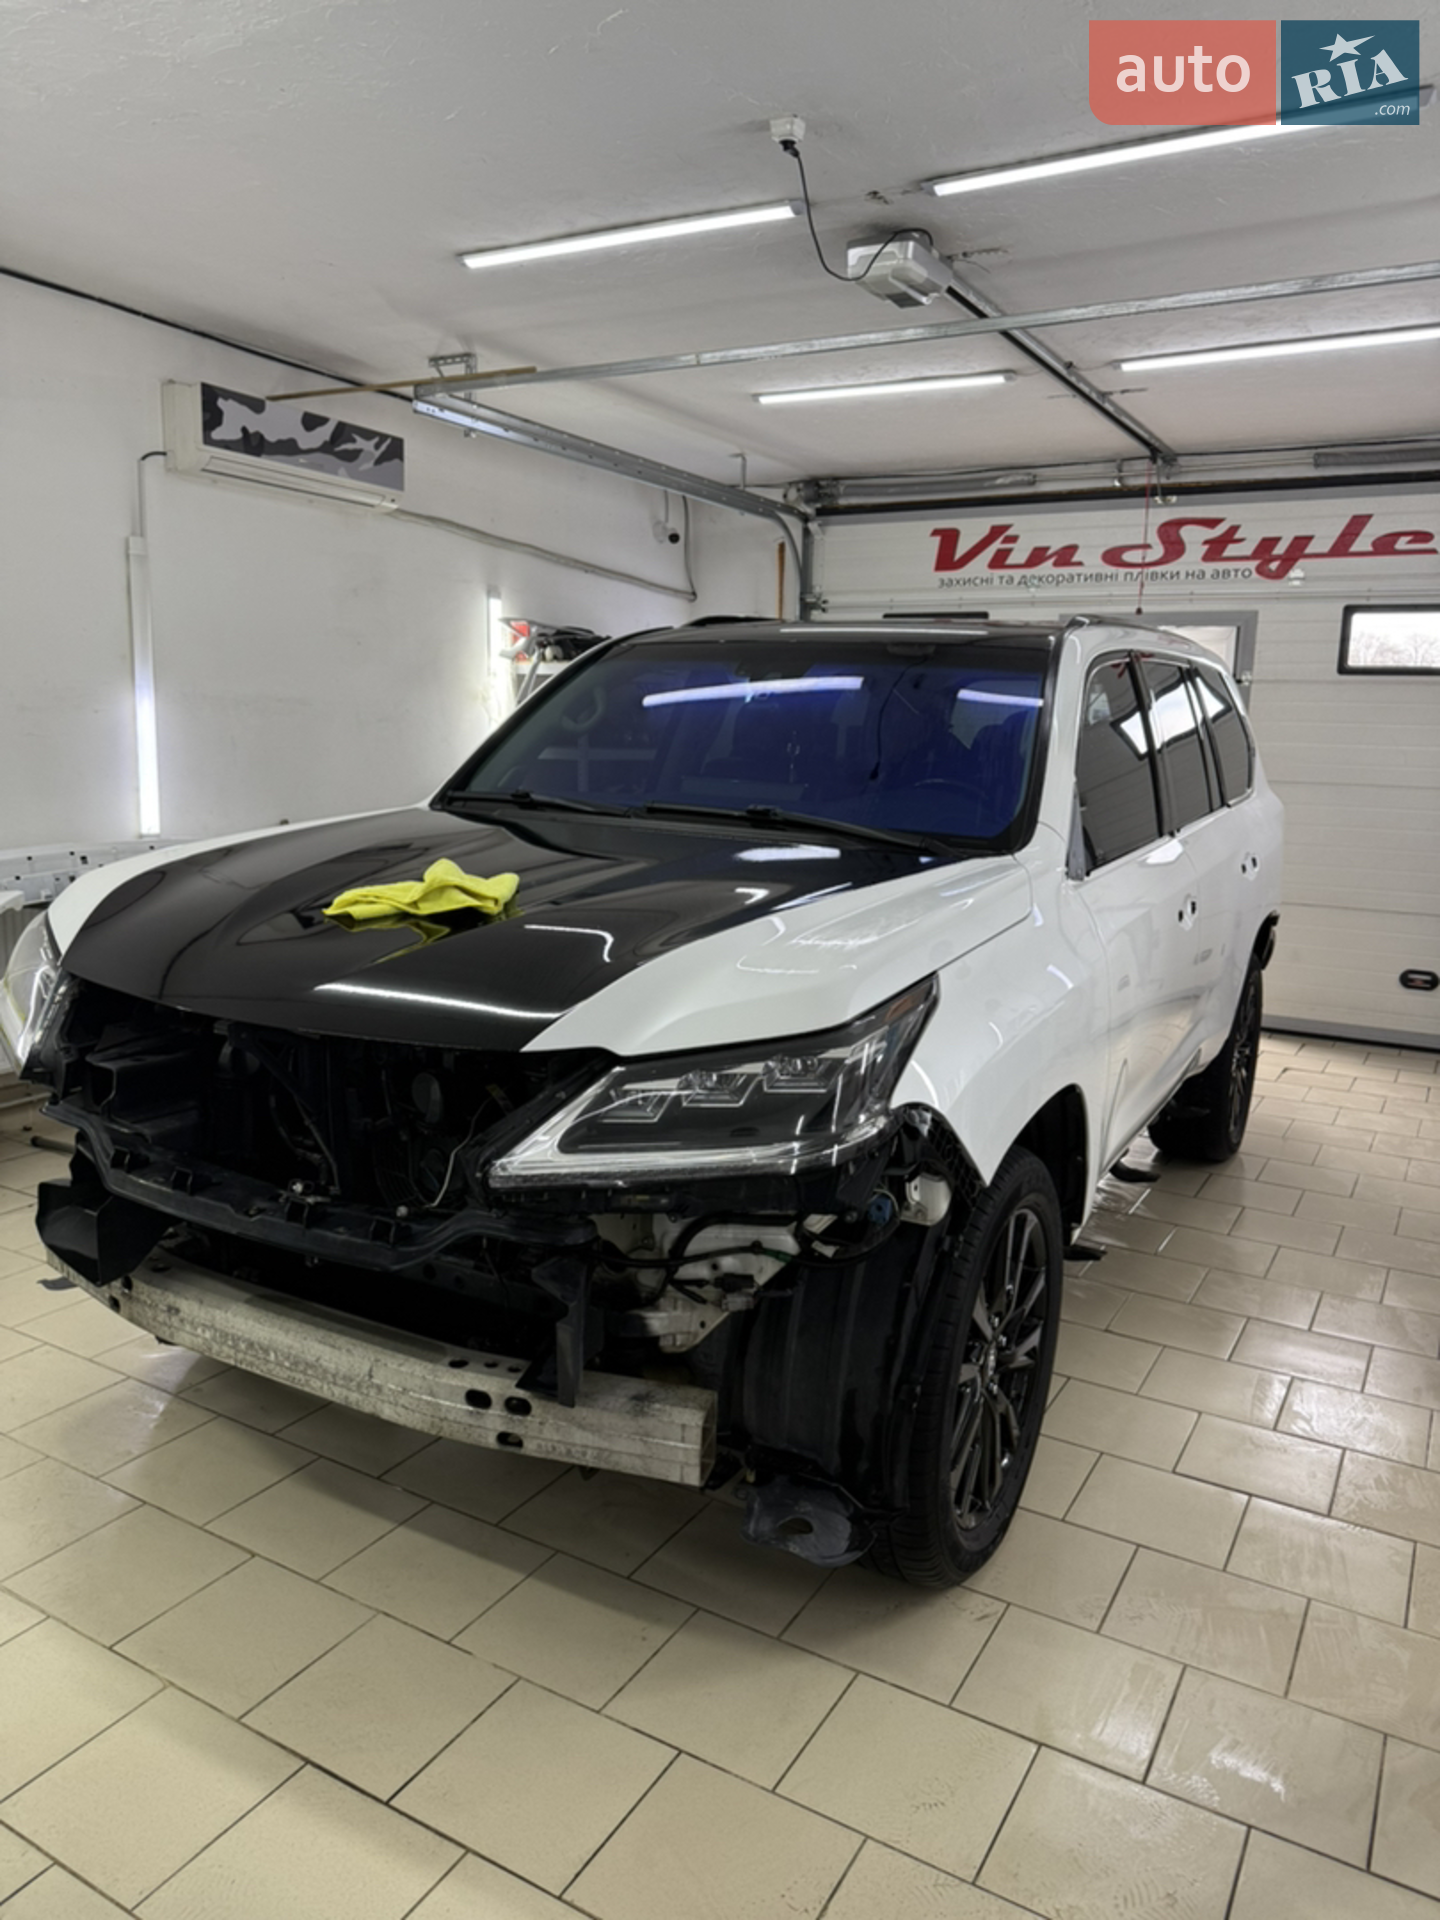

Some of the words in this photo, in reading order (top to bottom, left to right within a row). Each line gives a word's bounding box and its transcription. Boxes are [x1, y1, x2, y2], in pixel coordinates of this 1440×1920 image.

[930, 523, 1085, 572] Vin
[1101, 513, 1439, 580] Style
[938, 572, 994, 589] захисні
[998, 575, 1015, 586] та
[1017, 568, 1119, 587] декоративні
[1123, 567, 1181, 583] плівки
[1185, 570, 1206, 581] на
[1210, 567, 1253, 581] авто
